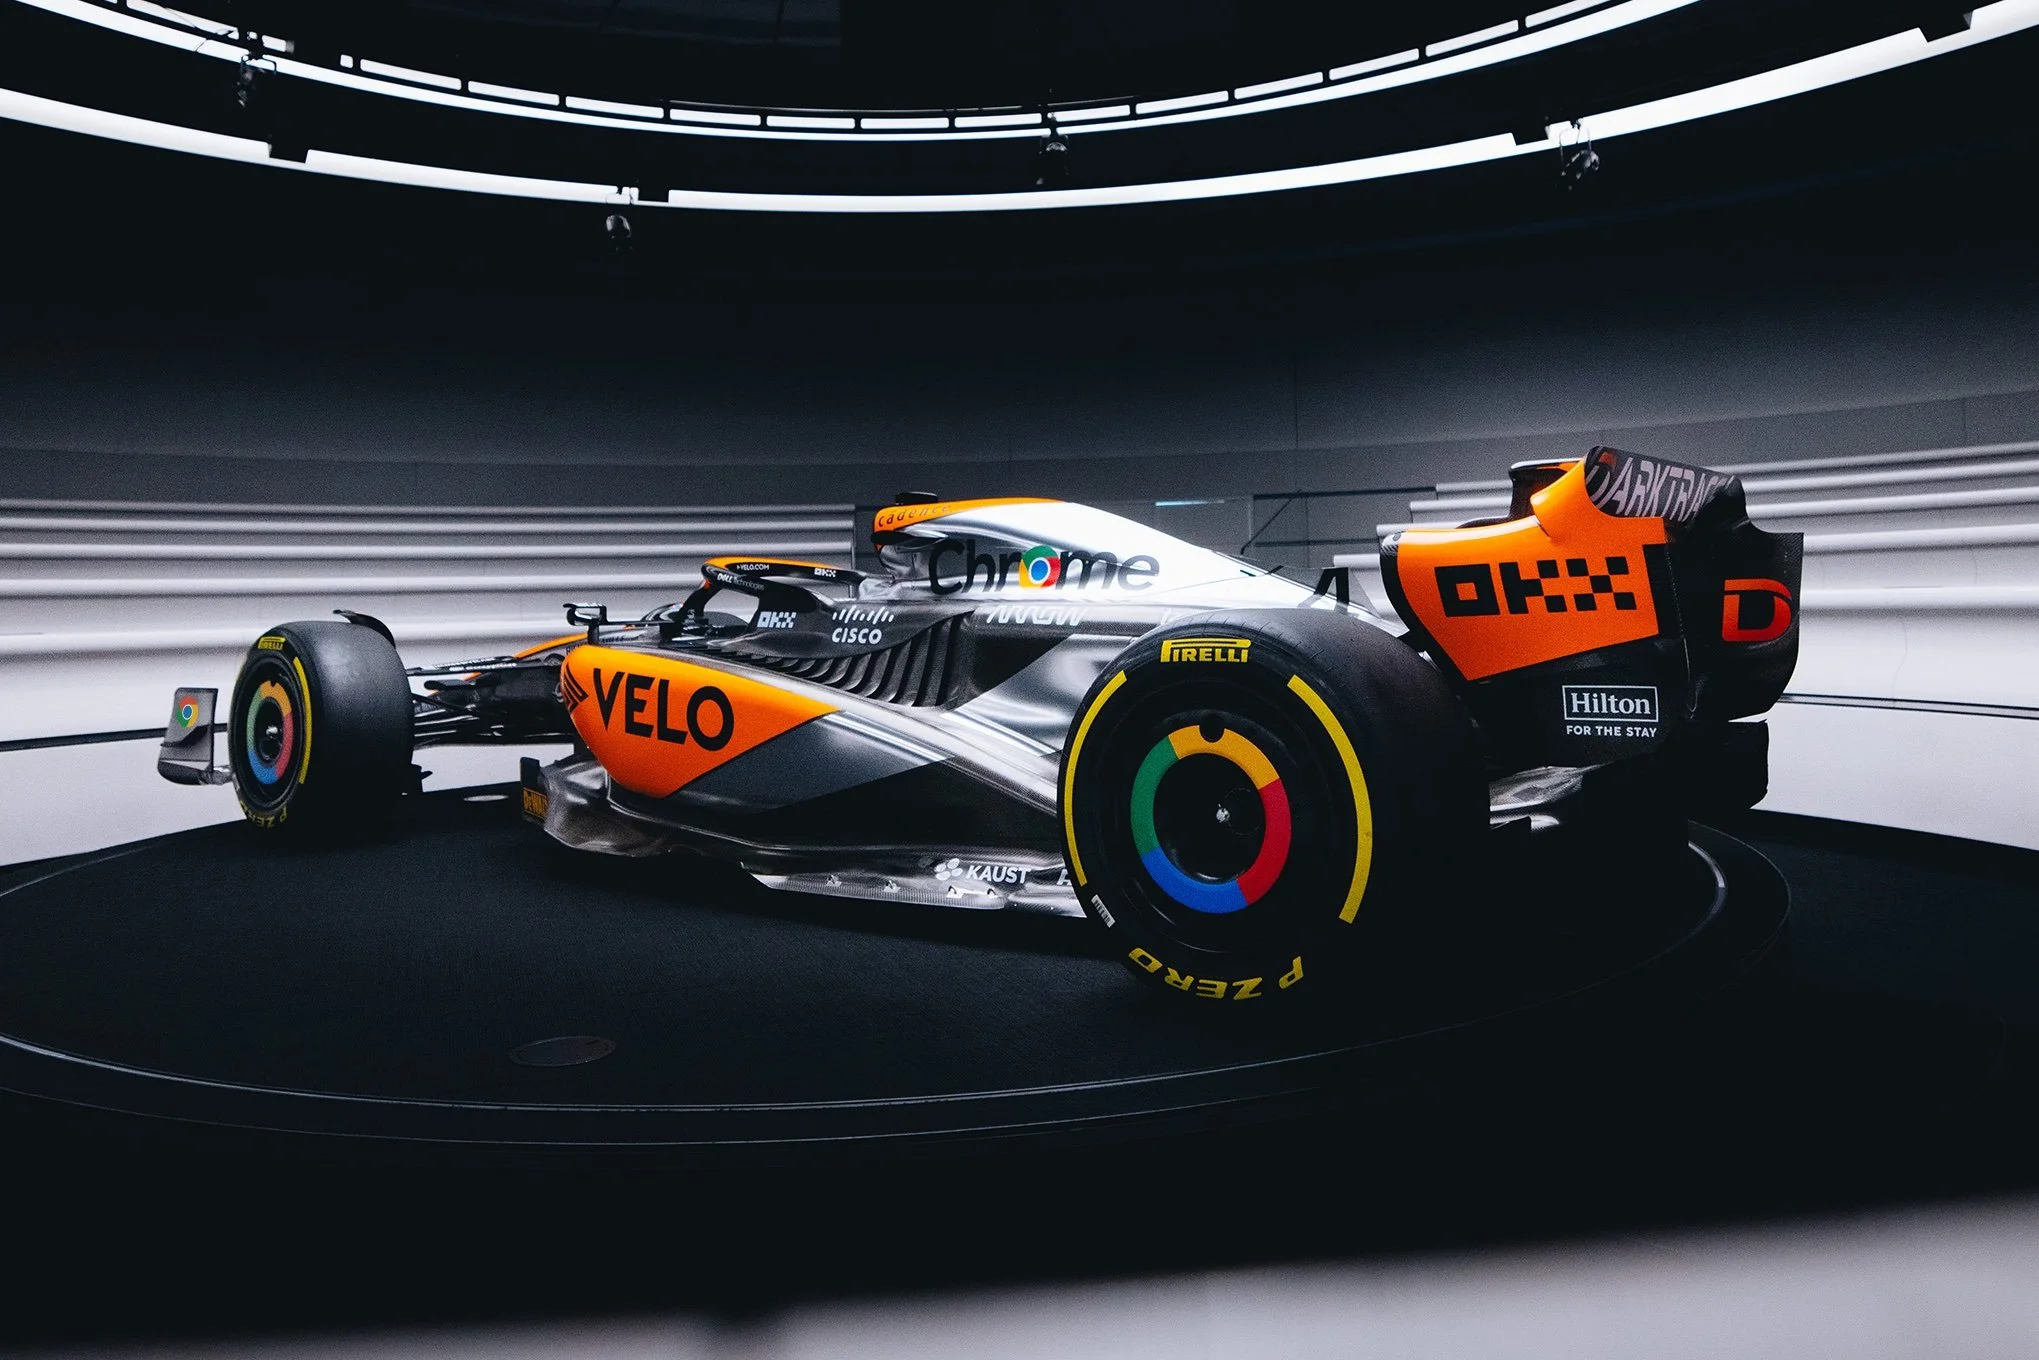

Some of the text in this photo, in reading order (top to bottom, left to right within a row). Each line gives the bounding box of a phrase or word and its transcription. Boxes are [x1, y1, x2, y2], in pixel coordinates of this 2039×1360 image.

[929, 540, 1160, 595] Chrome
[1434, 556, 1637, 618] OKX
[757, 611, 797, 628] OKX
[832, 627, 882, 644] CISCO
[1160, 638, 1252, 662] PIRELLI
[593, 668, 735, 751] VELO
[1571, 693, 1651, 714] Hilton
[1566, 725, 1657, 737] FOR THE STAY
[965, 865, 1031, 884] KAUST
[1128, 947, 1304, 1000] P ZERO
